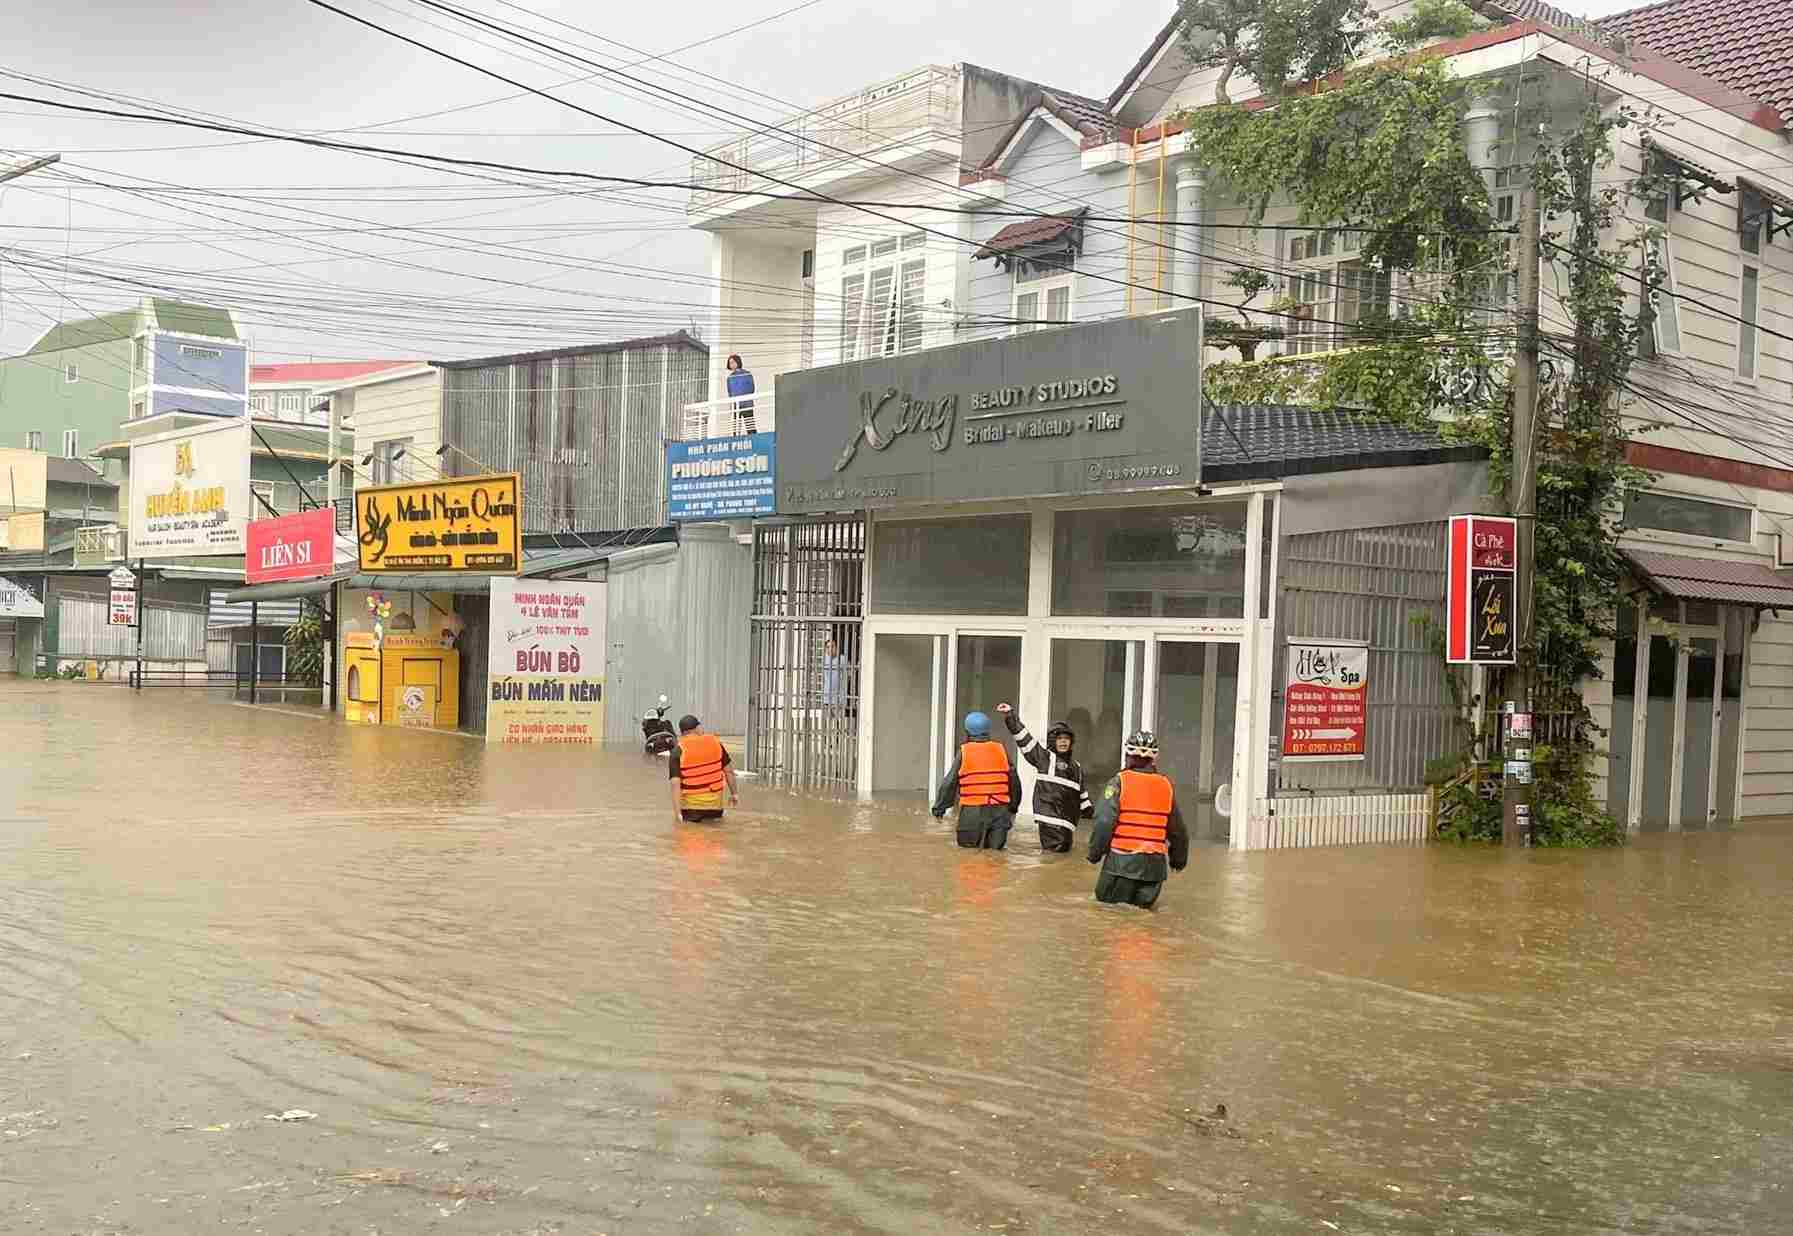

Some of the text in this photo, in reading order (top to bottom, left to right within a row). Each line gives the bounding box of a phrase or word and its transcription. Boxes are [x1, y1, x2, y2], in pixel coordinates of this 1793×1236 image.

[971, 374, 1118, 409] BEAUTY STUDIOS
[261, 537, 295, 569] LIÊN
[1474, 533, 1505, 549] Cà Phê
[516, 643, 580, 673] BÚN BÒ
[491, 676, 602, 701] BÚN MẮM NÊM
[1340, 667, 1361, 686] Spa
